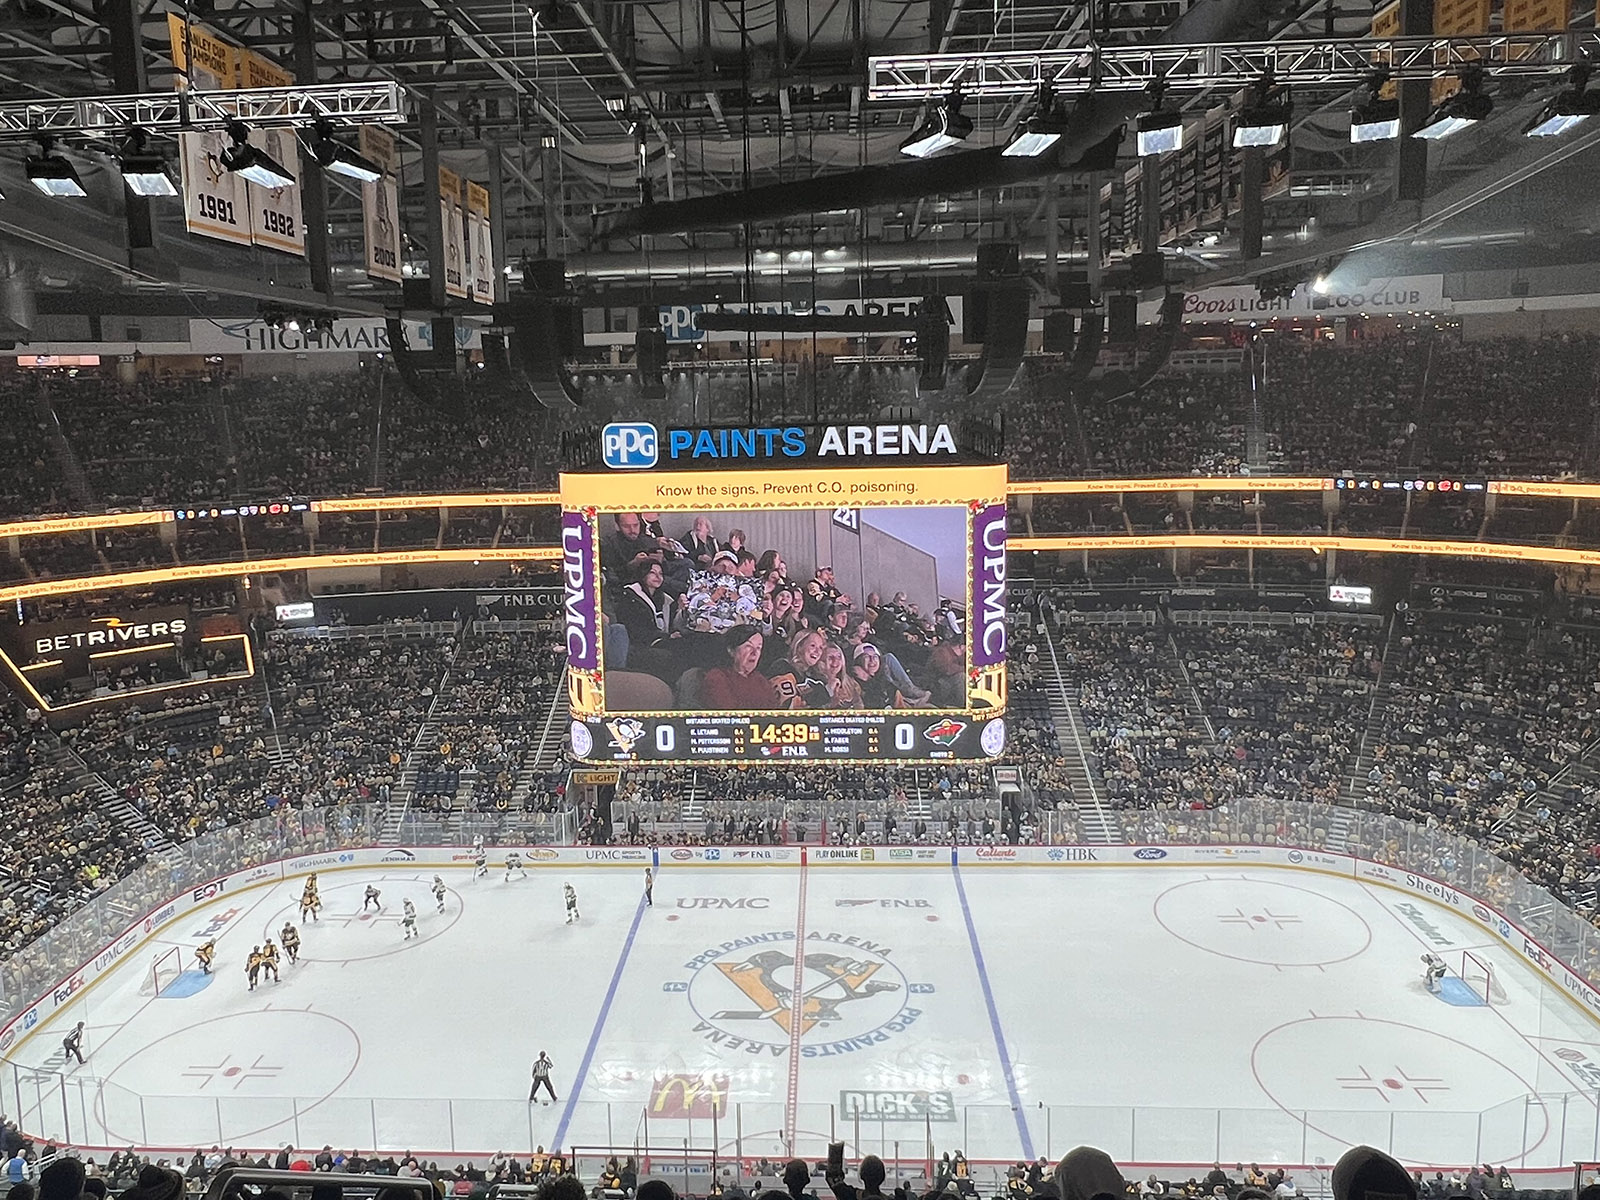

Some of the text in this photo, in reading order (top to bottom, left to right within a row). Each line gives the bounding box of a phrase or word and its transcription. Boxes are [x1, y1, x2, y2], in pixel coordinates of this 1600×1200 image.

[180, 26, 211, 53] SANLEY
[181, 41, 227, 75] CAMPIONS
[198, 193, 237, 225] 1991
[262, 209, 295, 238] 1992
[374, 246, 396, 269] 2009
[1182, 290, 1421, 314] Coors LIGHT ILOO CLUB
[245, 326, 393, 351] HIGHMAR
[606, 424, 958, 463] PPG PAINTS ARENA
[656, 481, 919, 498] Know the signs. Prevent C.O. poisoning.
[562, 525, 588, 660] UPMC
[983, 516, 1006, 657] UPMC
[1171, 588, 1216, 597] PENGUINS
[504, 594, 563, 607] F.N.B. CLU
[36, 618, 188, 655] BETRIVERS
[656, 724, 675, 752] 0
[750, 724, 808, 744] 14:39
[894, 724, 915, 751] 0
[631, 752, 638, 760] 2
[589, 774, 616, 783] LIGHT
[586, 850, 621, 860] UPMC
[750, 850, 771, 859] F.N.B.
[816, 850, 830, 859] PLAY
[830, 850, 859, 858] ONLINE
[976, 848, 1017, 858] Caliente
[1066, 848, 1098, 861] HBK
[1137, 849, 1164, 860] Ford
[193, 878, 229, 902] EQT
[1406, 874, 1460, 905] Sheely's
[676, 898, 770, 910] UPMC
[192, 906, 244, 938] FedEx
[94, 940, 125, 972] UPMC
[684, 930, 893, 971] PPG PAINTS ARENA
[1524, 938, 1553, 974] FedEx
[53, 974, 85, 1007] FedEx
[1564, 973, 1594, 1006] UPMC
[692, 1006, 923, 1059] PPG PAINTS ARENA
